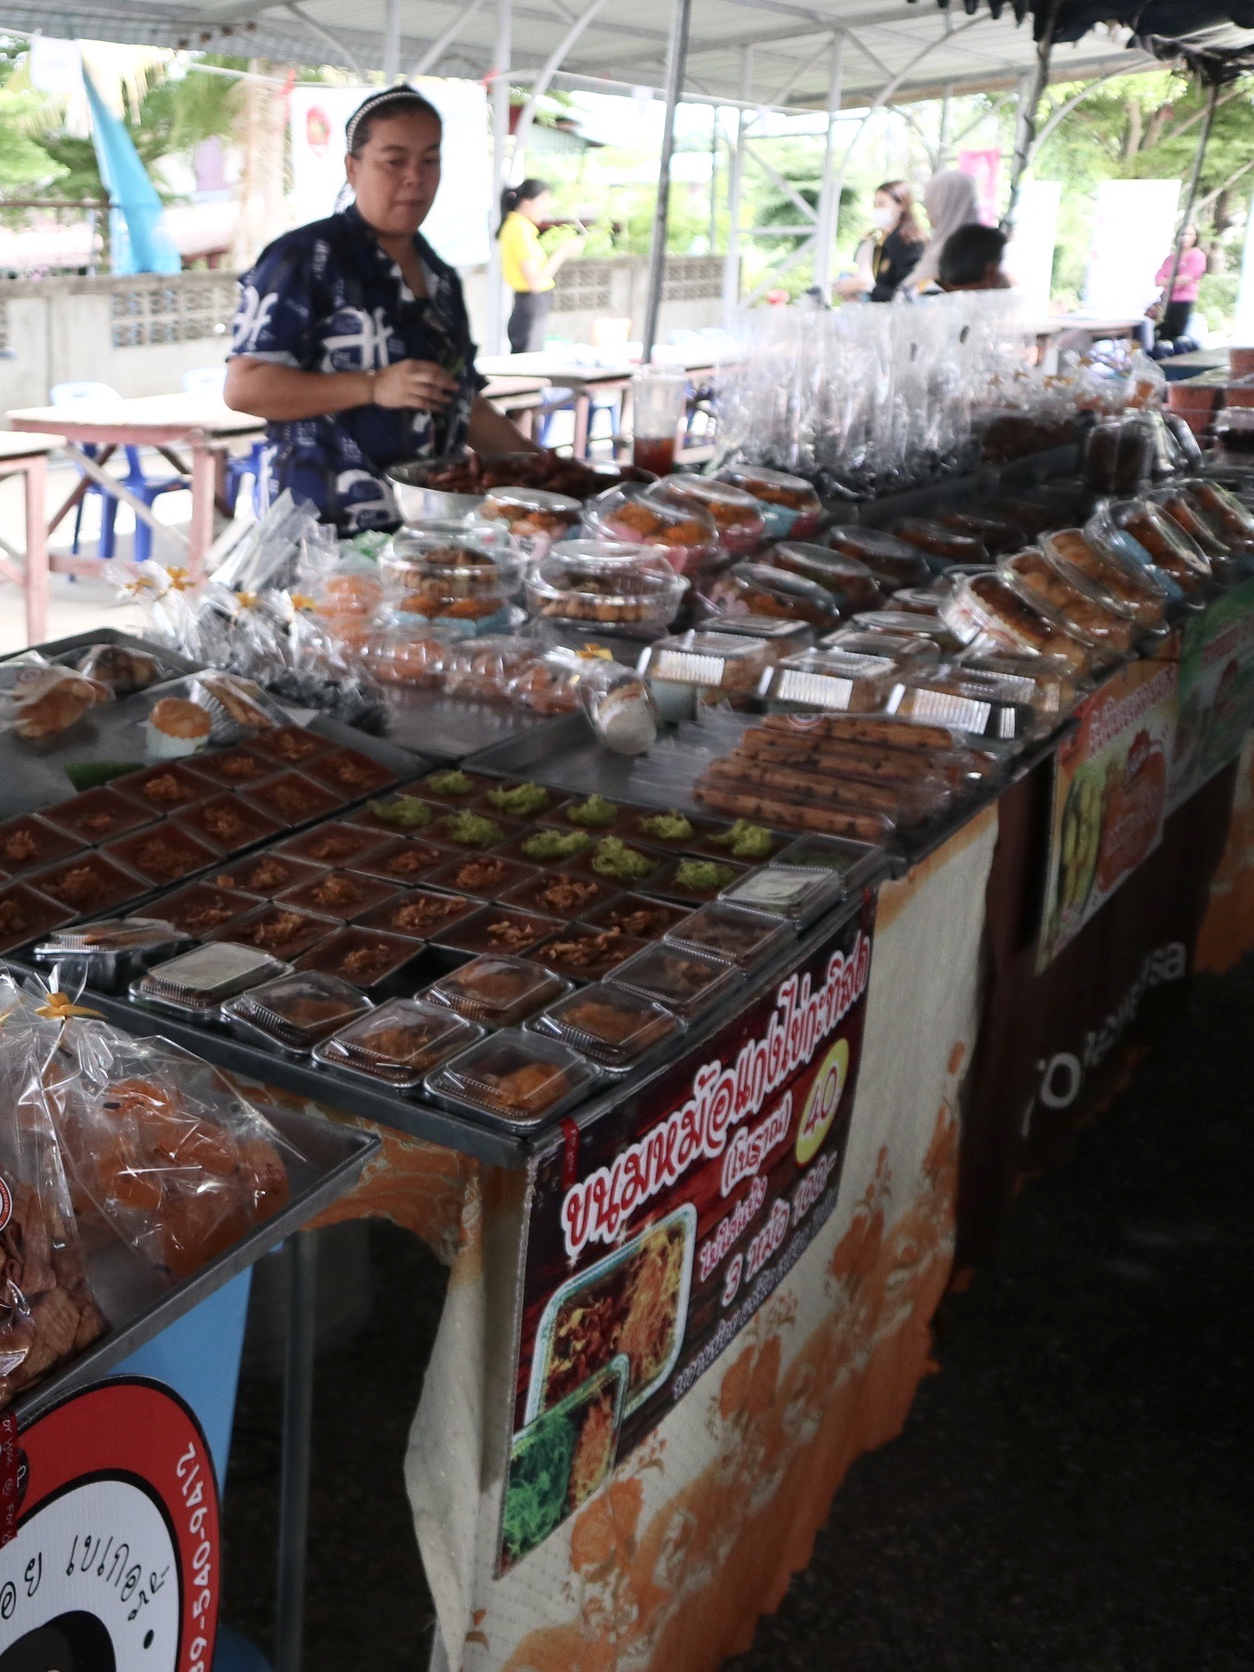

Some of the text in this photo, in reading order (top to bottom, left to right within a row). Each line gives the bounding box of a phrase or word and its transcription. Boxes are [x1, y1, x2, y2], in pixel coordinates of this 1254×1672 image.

[564, 931, 869, 1254] ขนมหม้อแกงไข่กะทิสด
[723, 1093, 791, 1196] (โบราณ)
[723, 1254, 743, 1306] 3
